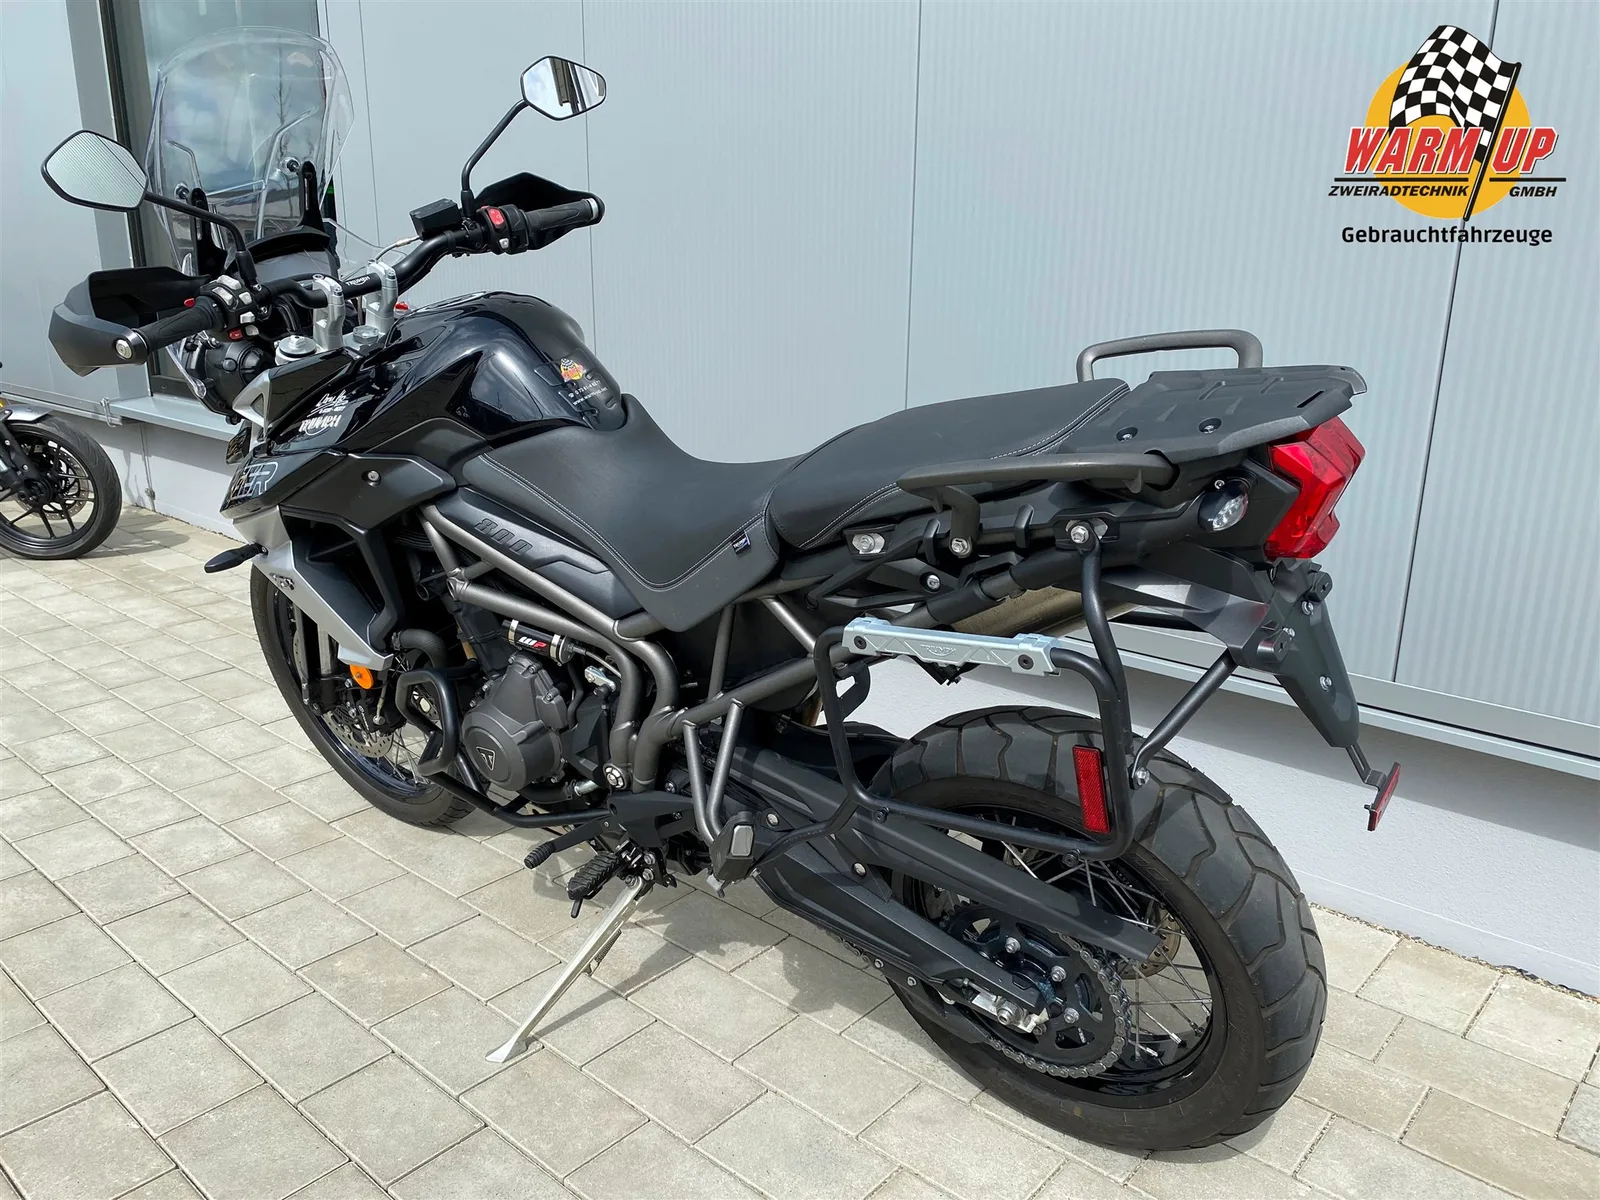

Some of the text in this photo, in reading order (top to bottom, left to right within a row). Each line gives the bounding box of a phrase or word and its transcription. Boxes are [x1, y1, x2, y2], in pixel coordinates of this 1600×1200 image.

[345, 275, 371, 286] TRIUMPH
[298, 414, 342, 435] TRIUMPH
[474, 518, 533, 556] 800
